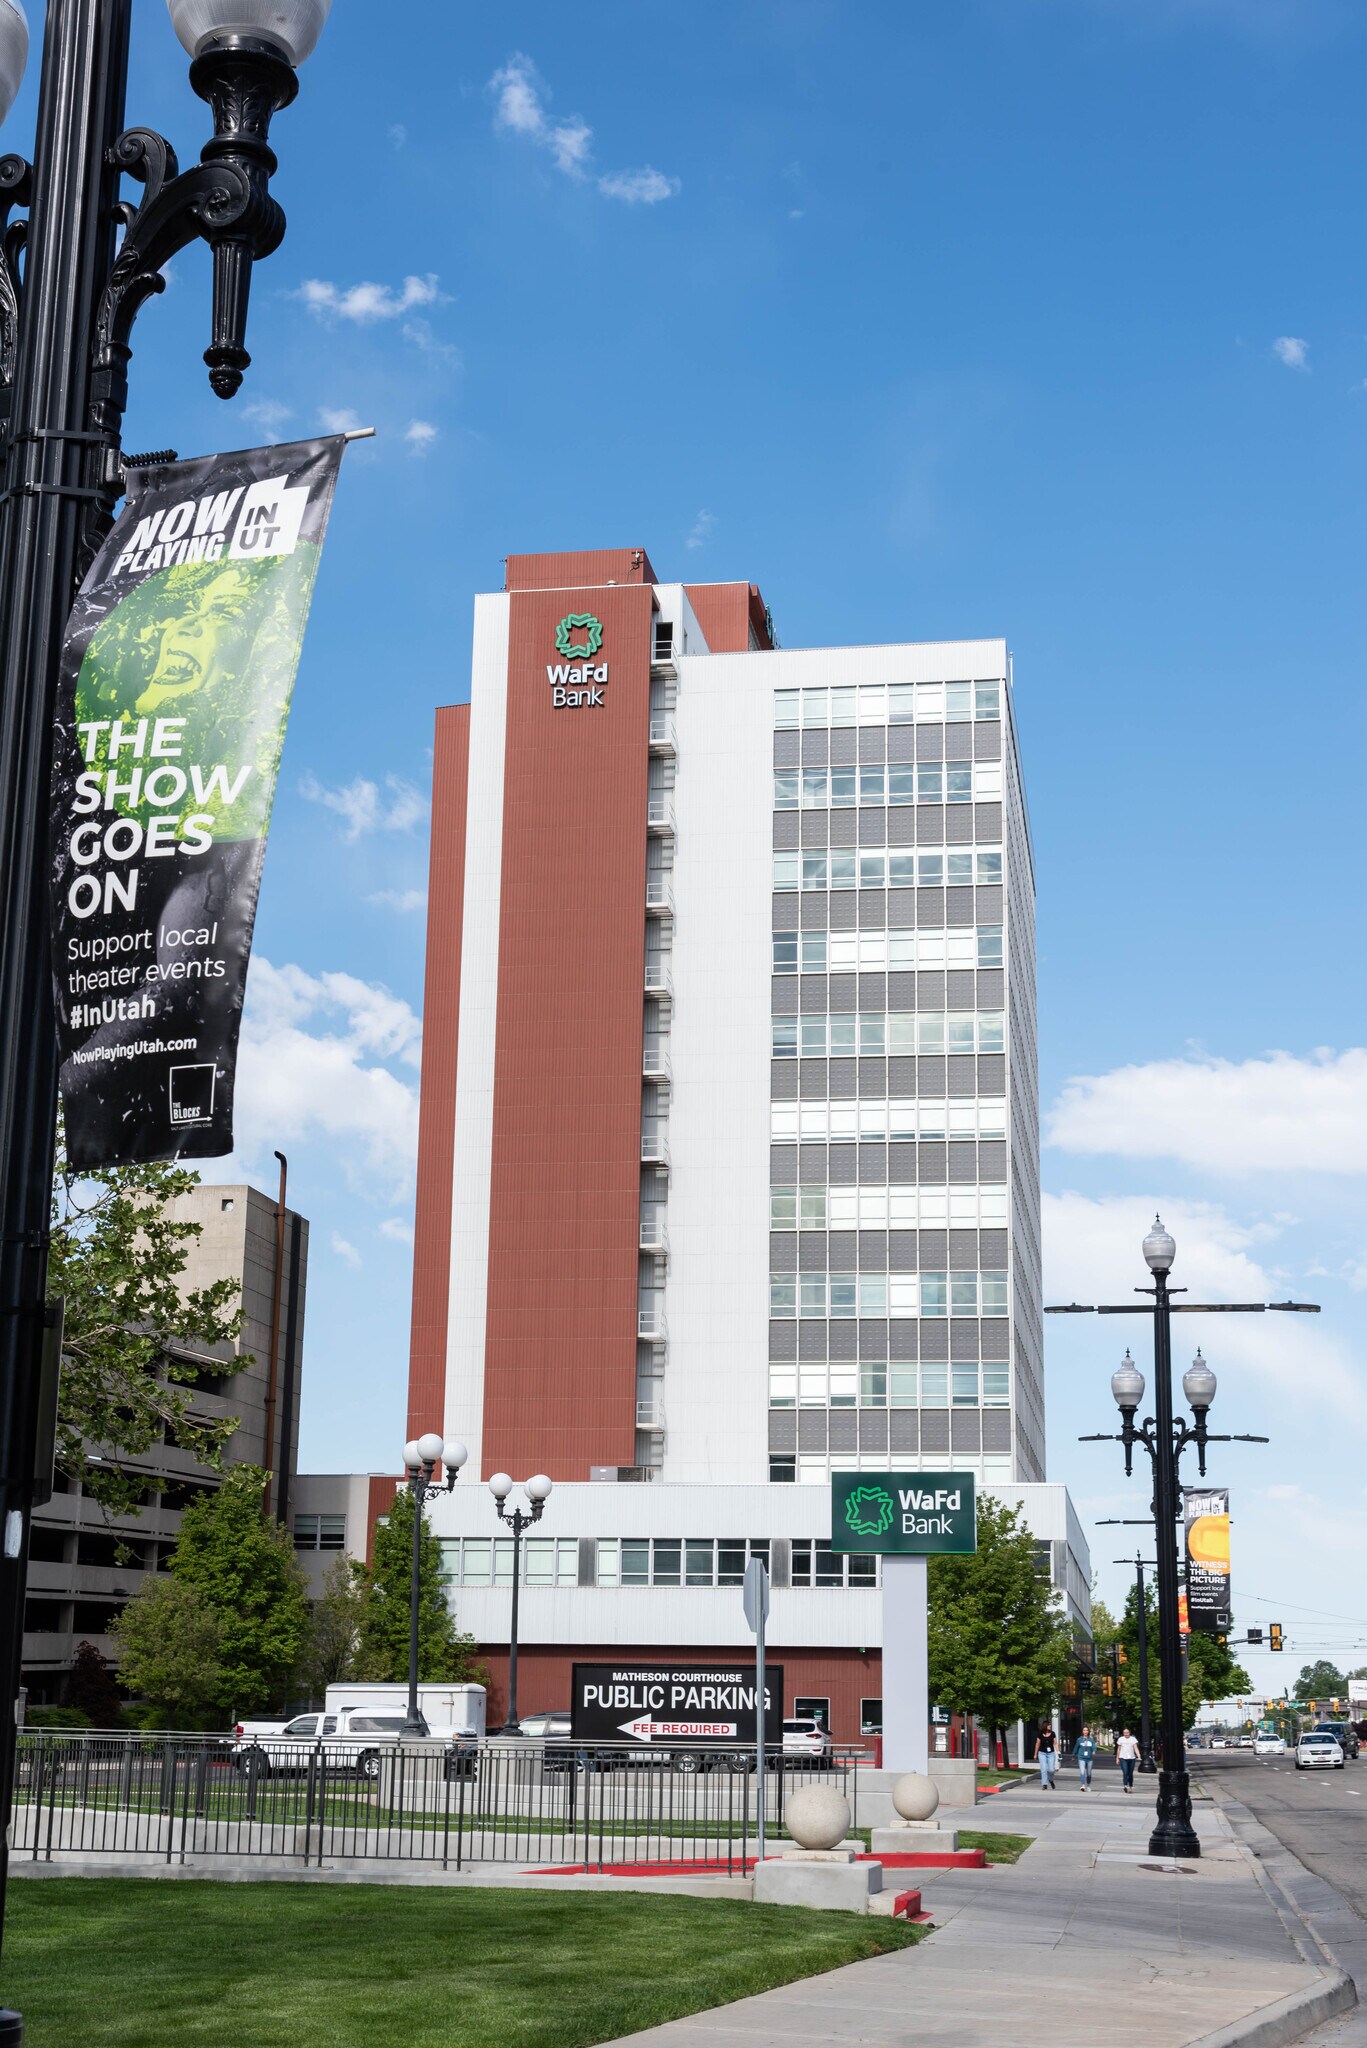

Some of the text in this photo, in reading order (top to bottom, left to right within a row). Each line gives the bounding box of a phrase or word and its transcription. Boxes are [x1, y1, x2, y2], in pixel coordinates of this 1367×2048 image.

[121, 486, 246, 554] NOW
[244, 505, 277, 528] IN
[239, 526, 280, 550] UT
[112, 532, 227, 576] PLAYING
[546, 663, 608, 684] WaFd
[553, 686, 604, 706] Bank
[78, 717, 186, 762] THE
[71, 765, 252, 814] SHOW
[70, 813, 215, 866] GOES
[68, 869, 139, 919] ON
[68, 922, 217, 961] Support local
[69, 957, 226, 993] theater events
[70, 994, 156, 1029] #InUtah
[73, 1038, 197, 1064] NowPlayingUtah.com
[174, 1106, 200, 1119] BLOCKS
[898, 1489, 961, 1511] WaFd
[902, 1513, 953, 1534] Bank
[1190, 1568, 1207, 1576] THE
[1190, 1576, 1226, 1584] PICTURE
[612, 1672, 743, 1682] MATHESON COURTHOUSE
[583, 1685, 665, 1709] PUBLIC
[633, 1723, 730, 1734] FEE REQUIRED
